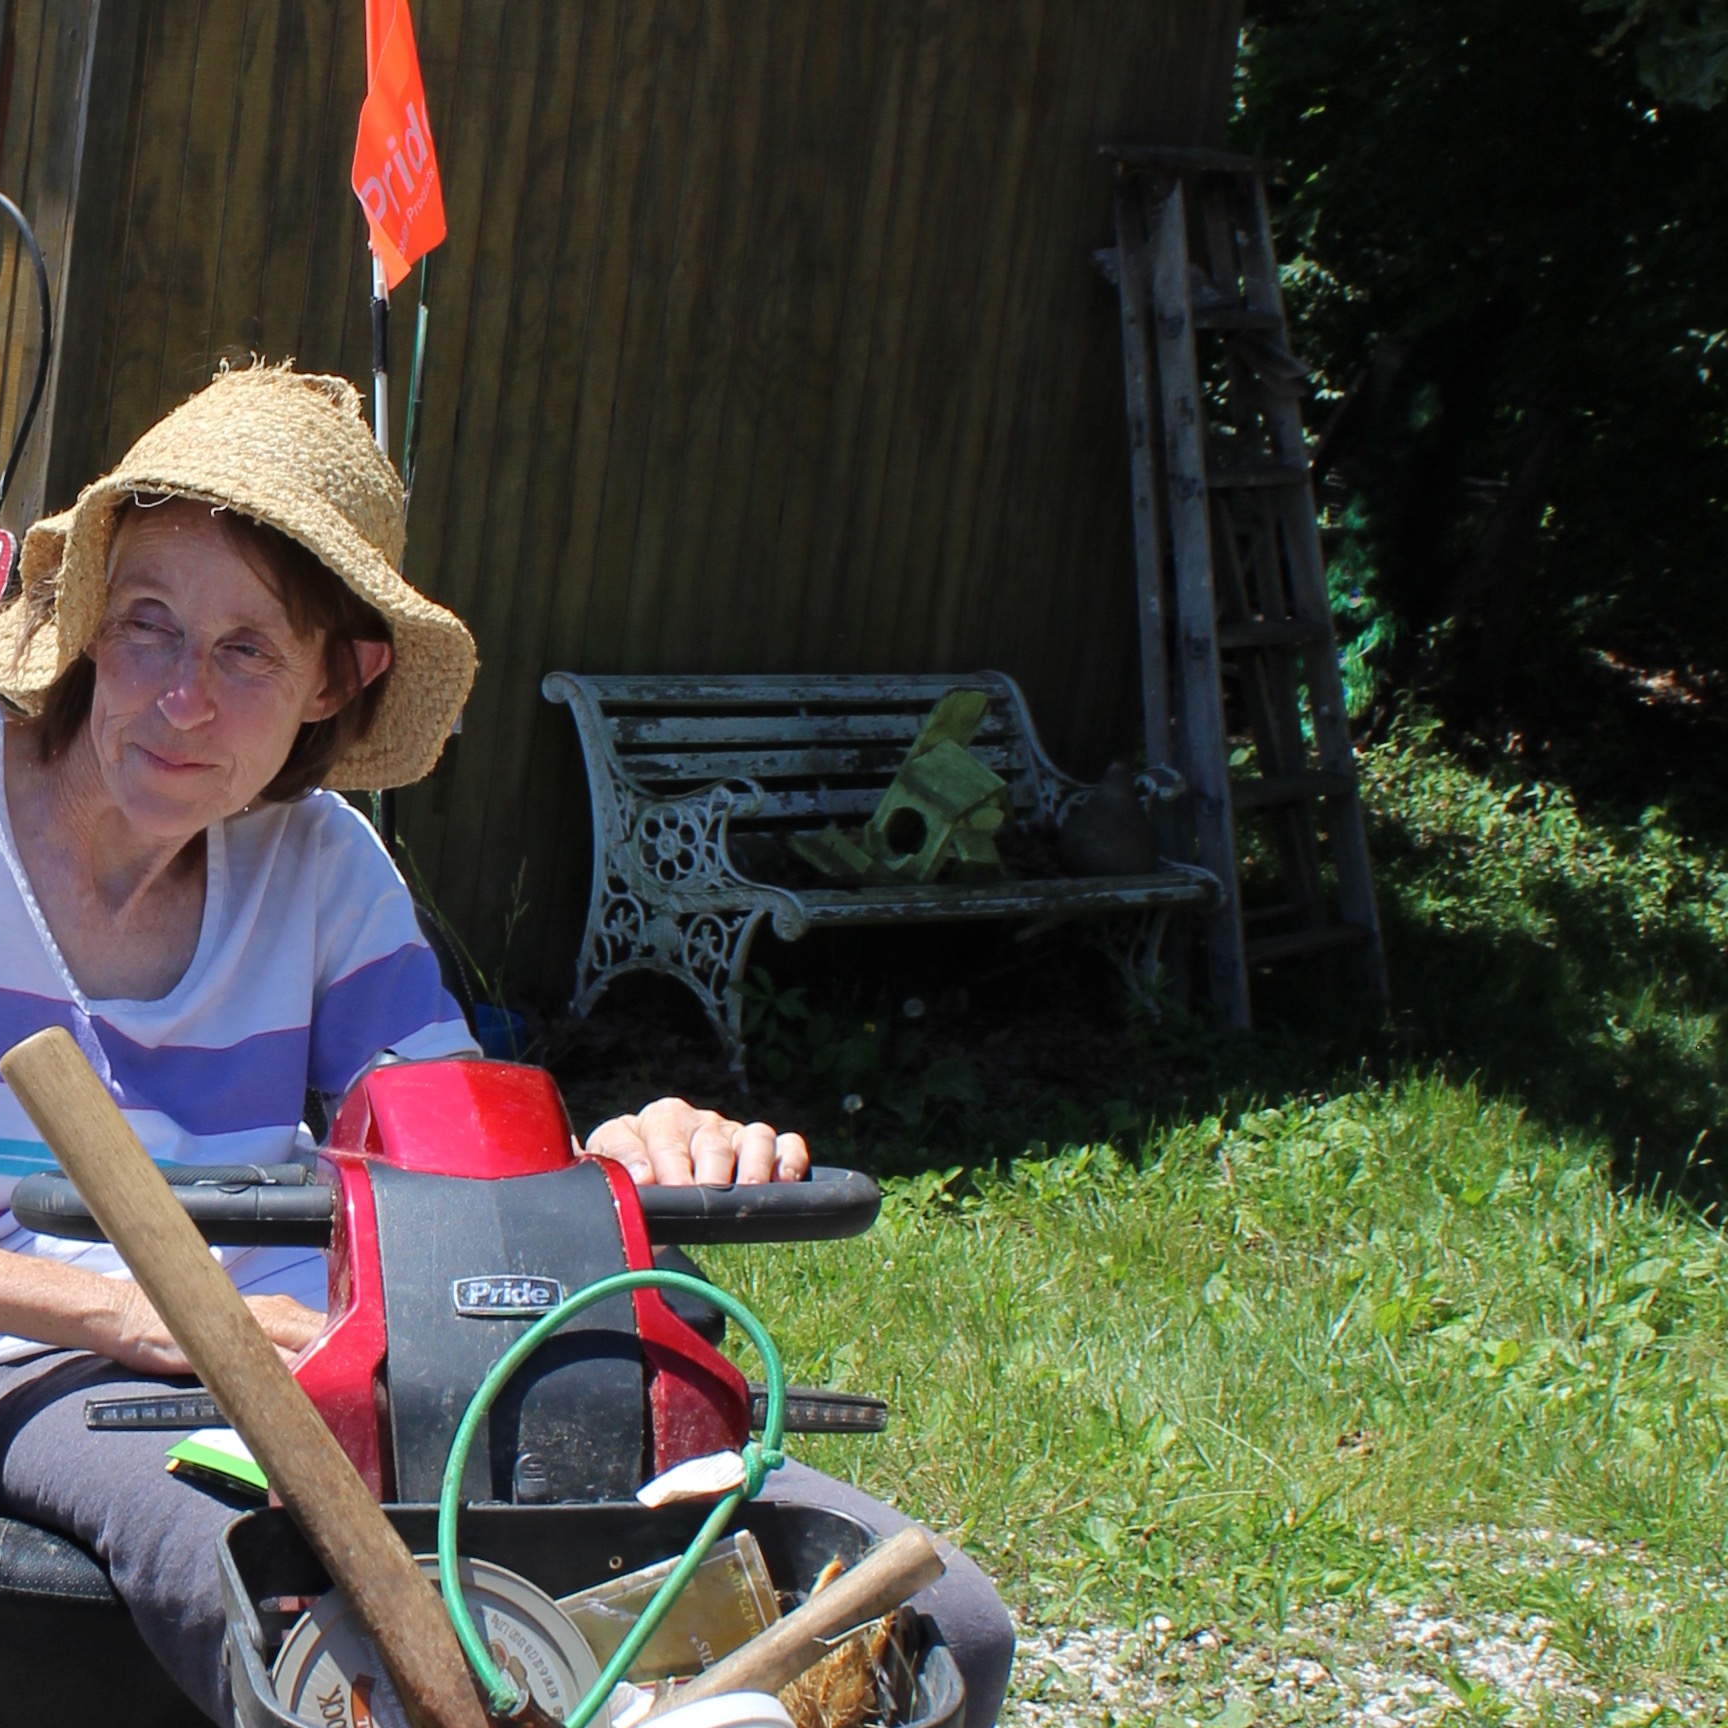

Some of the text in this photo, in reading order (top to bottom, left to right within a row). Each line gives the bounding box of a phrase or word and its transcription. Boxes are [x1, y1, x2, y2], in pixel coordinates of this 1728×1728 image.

[358, 96, 433, 223] Prid
[406, 167, 435, 224] Products
[468, 1280, 551, 1305] Pride
